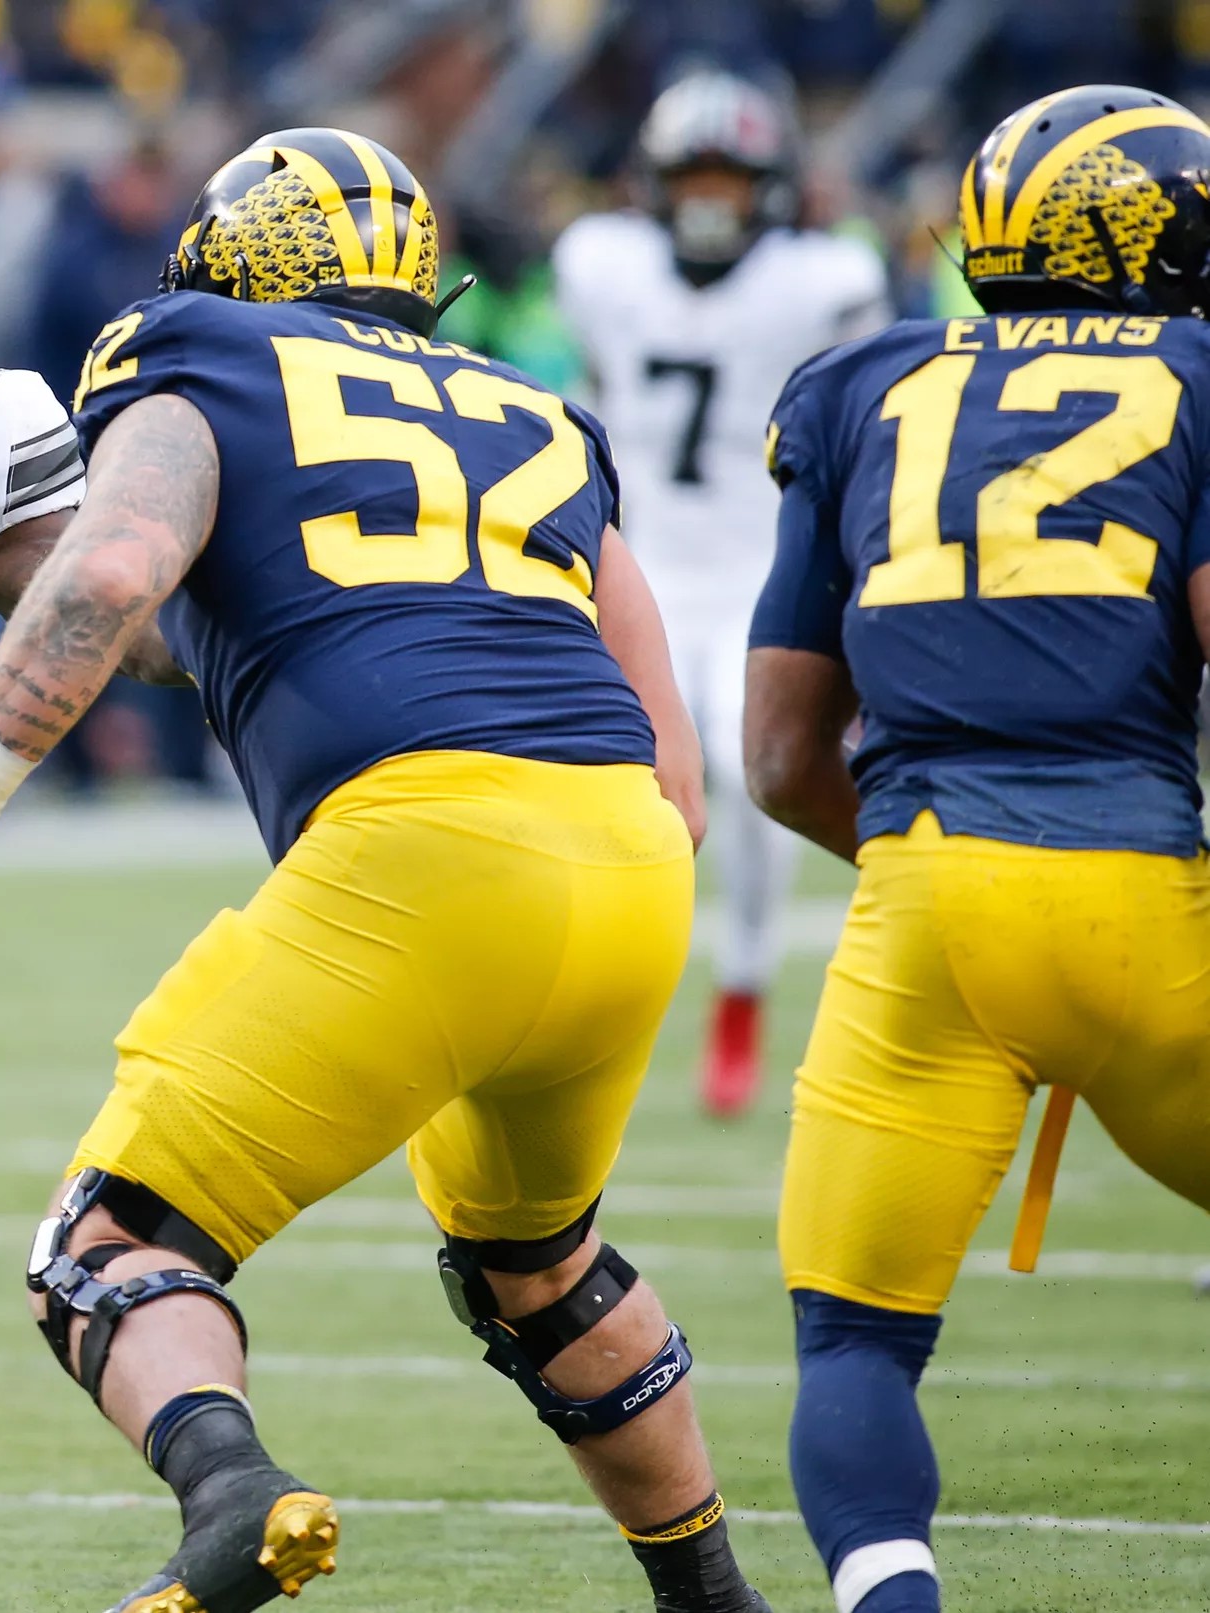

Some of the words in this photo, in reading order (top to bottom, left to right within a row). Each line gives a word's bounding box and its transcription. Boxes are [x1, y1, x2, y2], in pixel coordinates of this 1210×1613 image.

[318, 266, 341, 286] 52
[967, 251, 1024, 278] schutt
[944, 316, 1169, 352] EVANS
[645, 356, 717, 485] 7
[270, 335, 599, 633] 52
[858, 353, 1183, 608] 12
[622, 1354, 682, 1411] DONJOY
